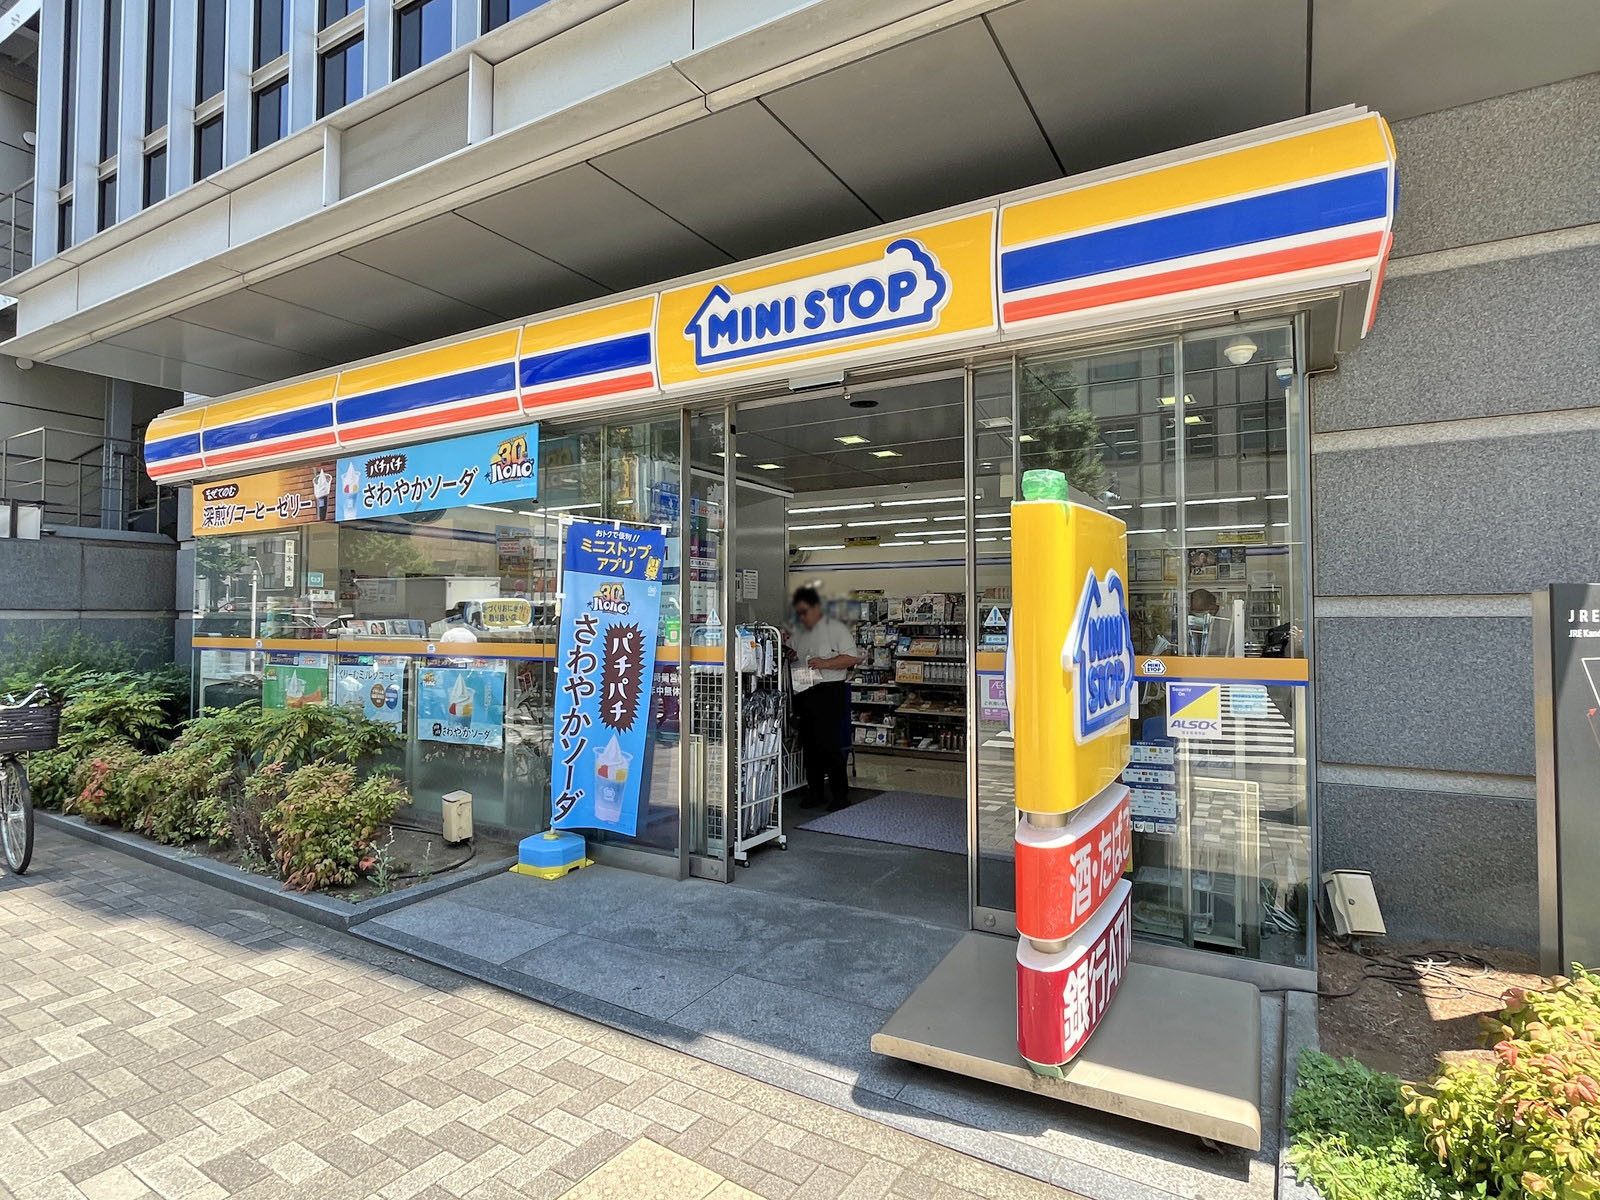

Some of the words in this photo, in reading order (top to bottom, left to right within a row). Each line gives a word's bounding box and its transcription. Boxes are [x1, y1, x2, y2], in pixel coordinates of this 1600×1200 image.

[708, 296, 796, 349] MINI
[803, 270, 918, 330] STOP
[369, 456, 404, 475] パチパチ
[363, 466, 479, 509] さわやかソーダ
[202, 494, 313, 528] 深煎りコーヒーゼリー
[580, 537, 652, 560] ミニストップ
[597, 556, 634, 575] アプリ
[1088, 614, 1125, 663] MINI
[1568, 628, 1583, 638] JRE
[339, 668, 397, 681] くりーむミルクコーヒ
[607, 631, 635, 723] パチパチ
[653, 672, 680, 683] 時間営
[1087, 657, 1126, 715] STOP
[553, 613, 599, 823] さわやかソーダ
[1170, 719, 1218, 731] ALSOK
[1063, 895, 1133, 1055] 銀行ATM
